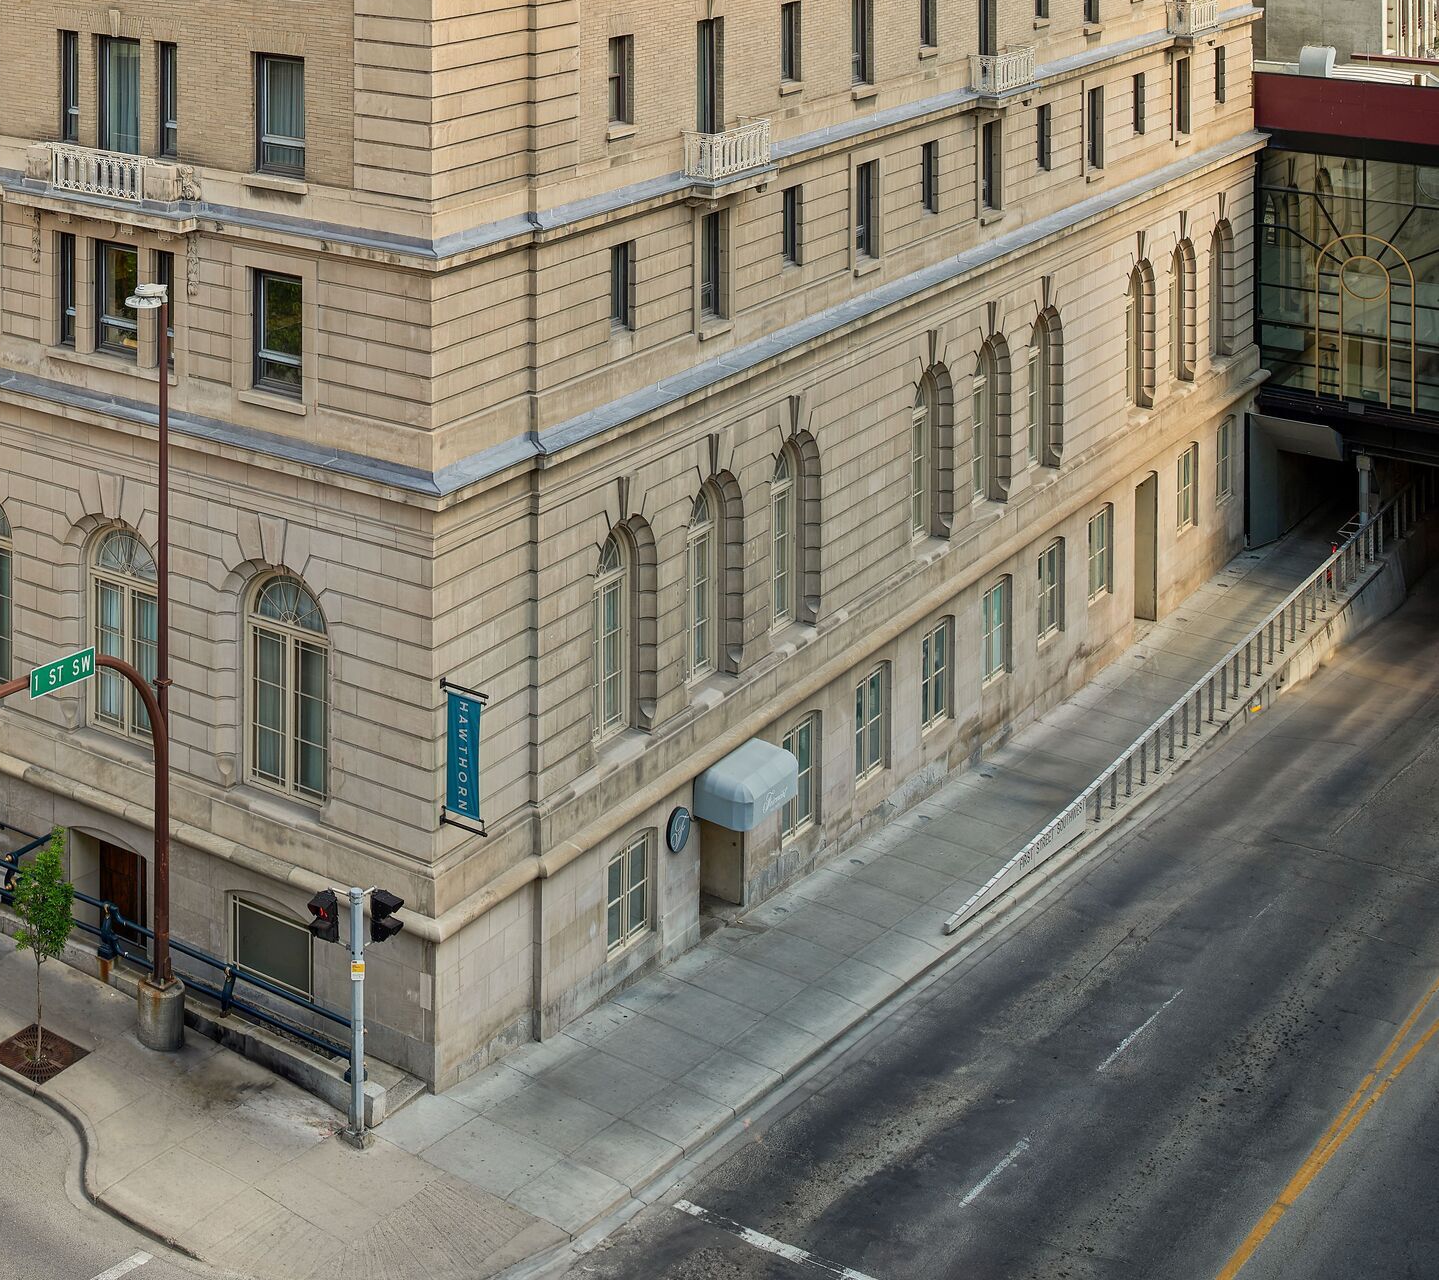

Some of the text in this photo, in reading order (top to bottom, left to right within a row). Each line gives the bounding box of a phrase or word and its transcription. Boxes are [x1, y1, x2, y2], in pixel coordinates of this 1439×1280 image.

[34, 654, 91, 692] 1 ST SW
[458, 700, 469, 812] HAWTHORN
[1019, 798, 1086, 871] FIRST STREET SOUTHWEST
